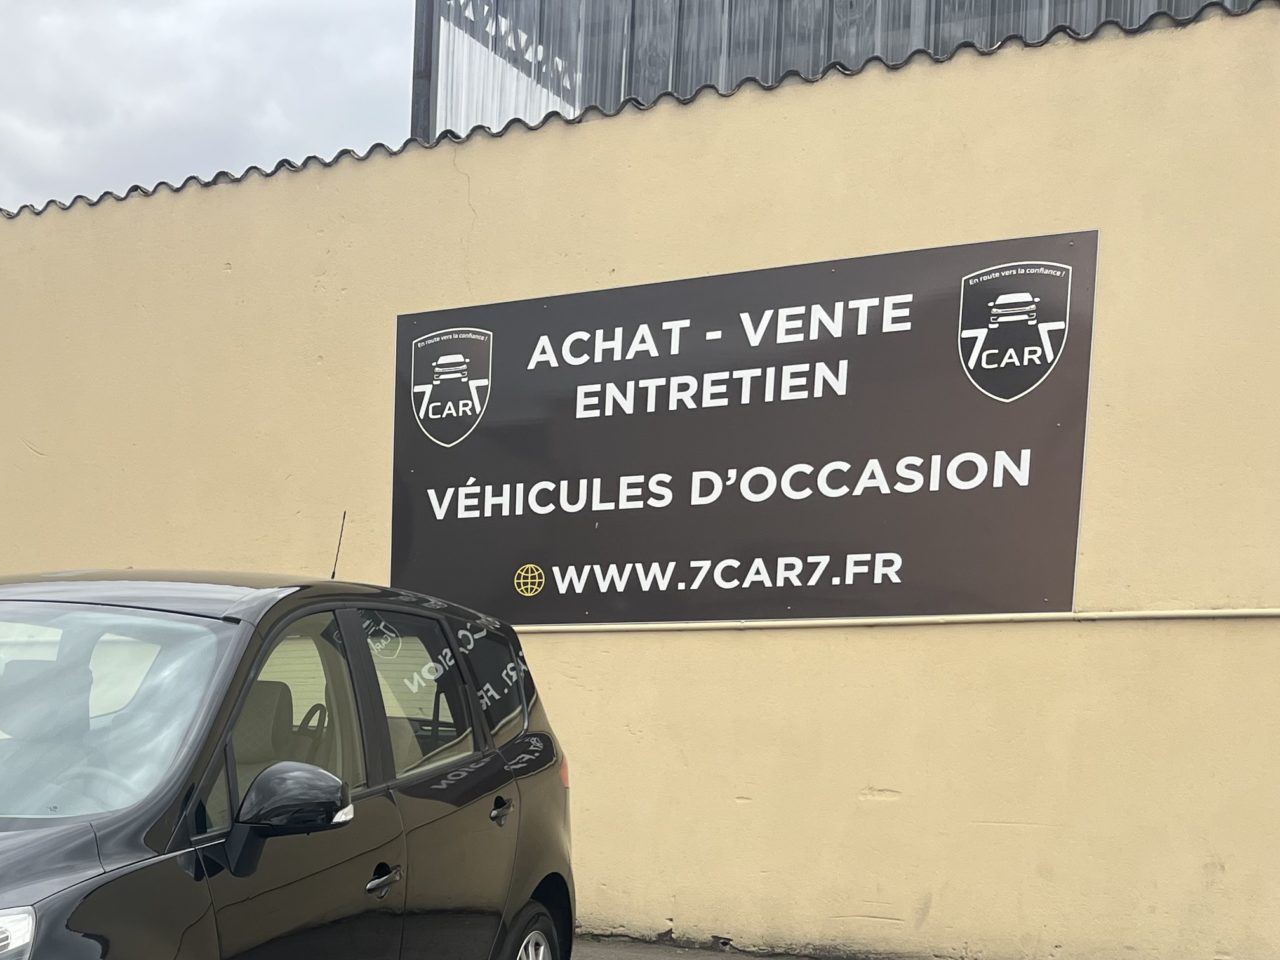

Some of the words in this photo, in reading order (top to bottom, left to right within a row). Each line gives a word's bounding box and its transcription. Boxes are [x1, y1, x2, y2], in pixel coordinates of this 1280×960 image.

[980, 271, 1000, 281] route
[1001, 269, 1017, 277] vers
[1026, 267, 1061, 277] confiance
[527, 319, 691, 370] ACHAT
[739, 294, 914, 347] VENTE
[575, 360, 849, 419] ENTRETIEN
[427, 471, 673, 520] VÉHICULES
[552, 553, 902, 593] WWW.7CAR7.FR
